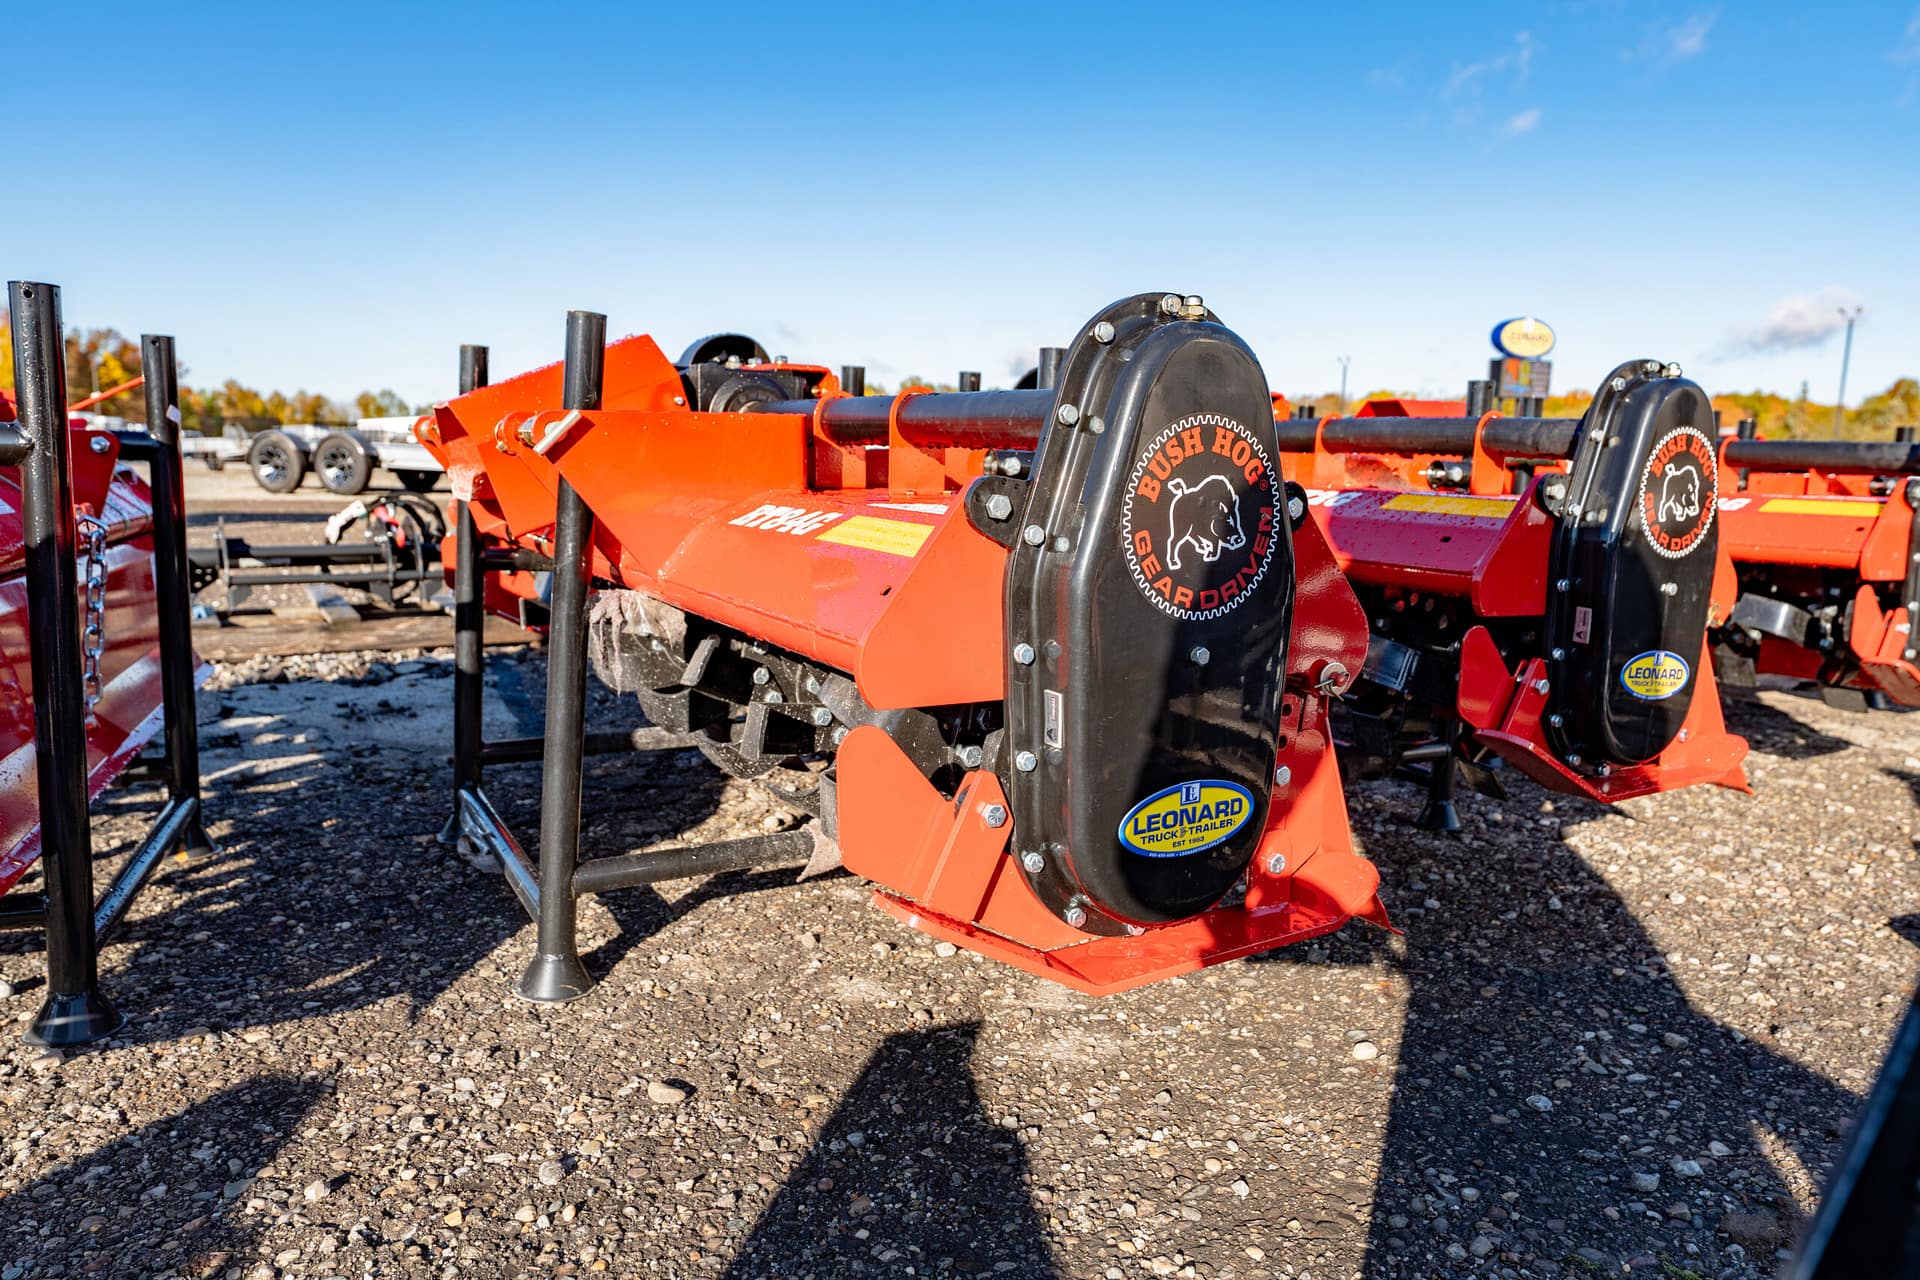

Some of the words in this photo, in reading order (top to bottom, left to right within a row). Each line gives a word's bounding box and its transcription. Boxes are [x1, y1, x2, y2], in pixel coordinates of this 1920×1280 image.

[1137, 427, 1205, 504] BUSH
[1650, 433, 1688, 478] BUSH
[1645, 492, 1670, 548] GEAR
[1670, 491, 1713, 550] DRIVEN
[1134, 529, 1194, 609] GEAR
[1199, 506, 1274, 609] DRIVEN
[1628, 667, 1683, 680] LEONARD
[1133, 797, 1243, 835] LEONARD
[1140, 829, 1178, 845] TRUCK
[1188, 818, 1233, 835] TRAILER
[1172, 839, 1186, 848] EST
